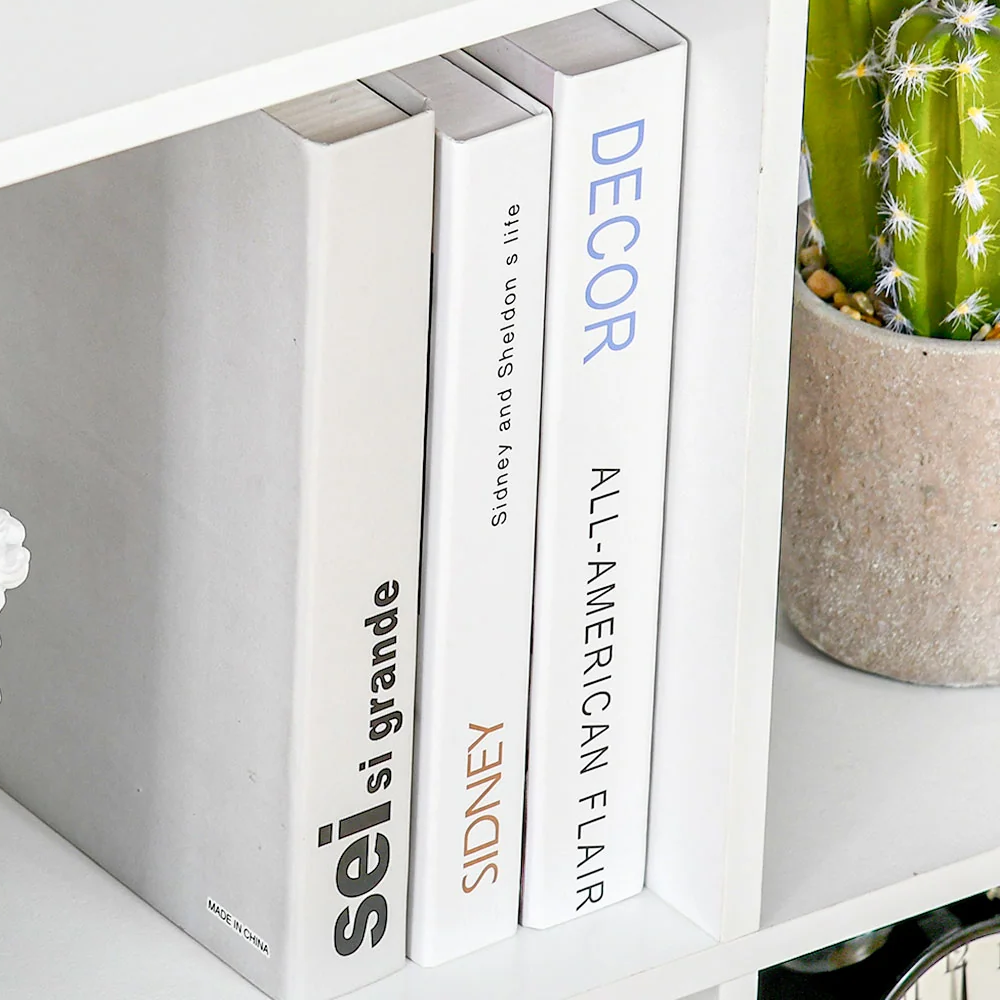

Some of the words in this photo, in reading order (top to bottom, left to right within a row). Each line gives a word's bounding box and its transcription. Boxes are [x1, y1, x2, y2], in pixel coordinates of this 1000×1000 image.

[504, 204, 520, 245] life
[582, 118, 645, 365] DECOR
[497, 277, 517, 379] Sheldon
[497, 388, 512, 432] and
[491, 444, 512, 527] Sidney
[364, 579, 404, 741] grande
[579, 467, 620, 775] ALL-AMERICAN
[359, 752, 393, 794] si
[461, 722, 504, 894] SIDNEY
[318, 801, 391, 957] sei
[575, 790, 607, 912] FLAIR
[208, 900, 231, 925] MADE
[234, 920, 242, 933] IN
[244, 928, 268, 955] CHINA
